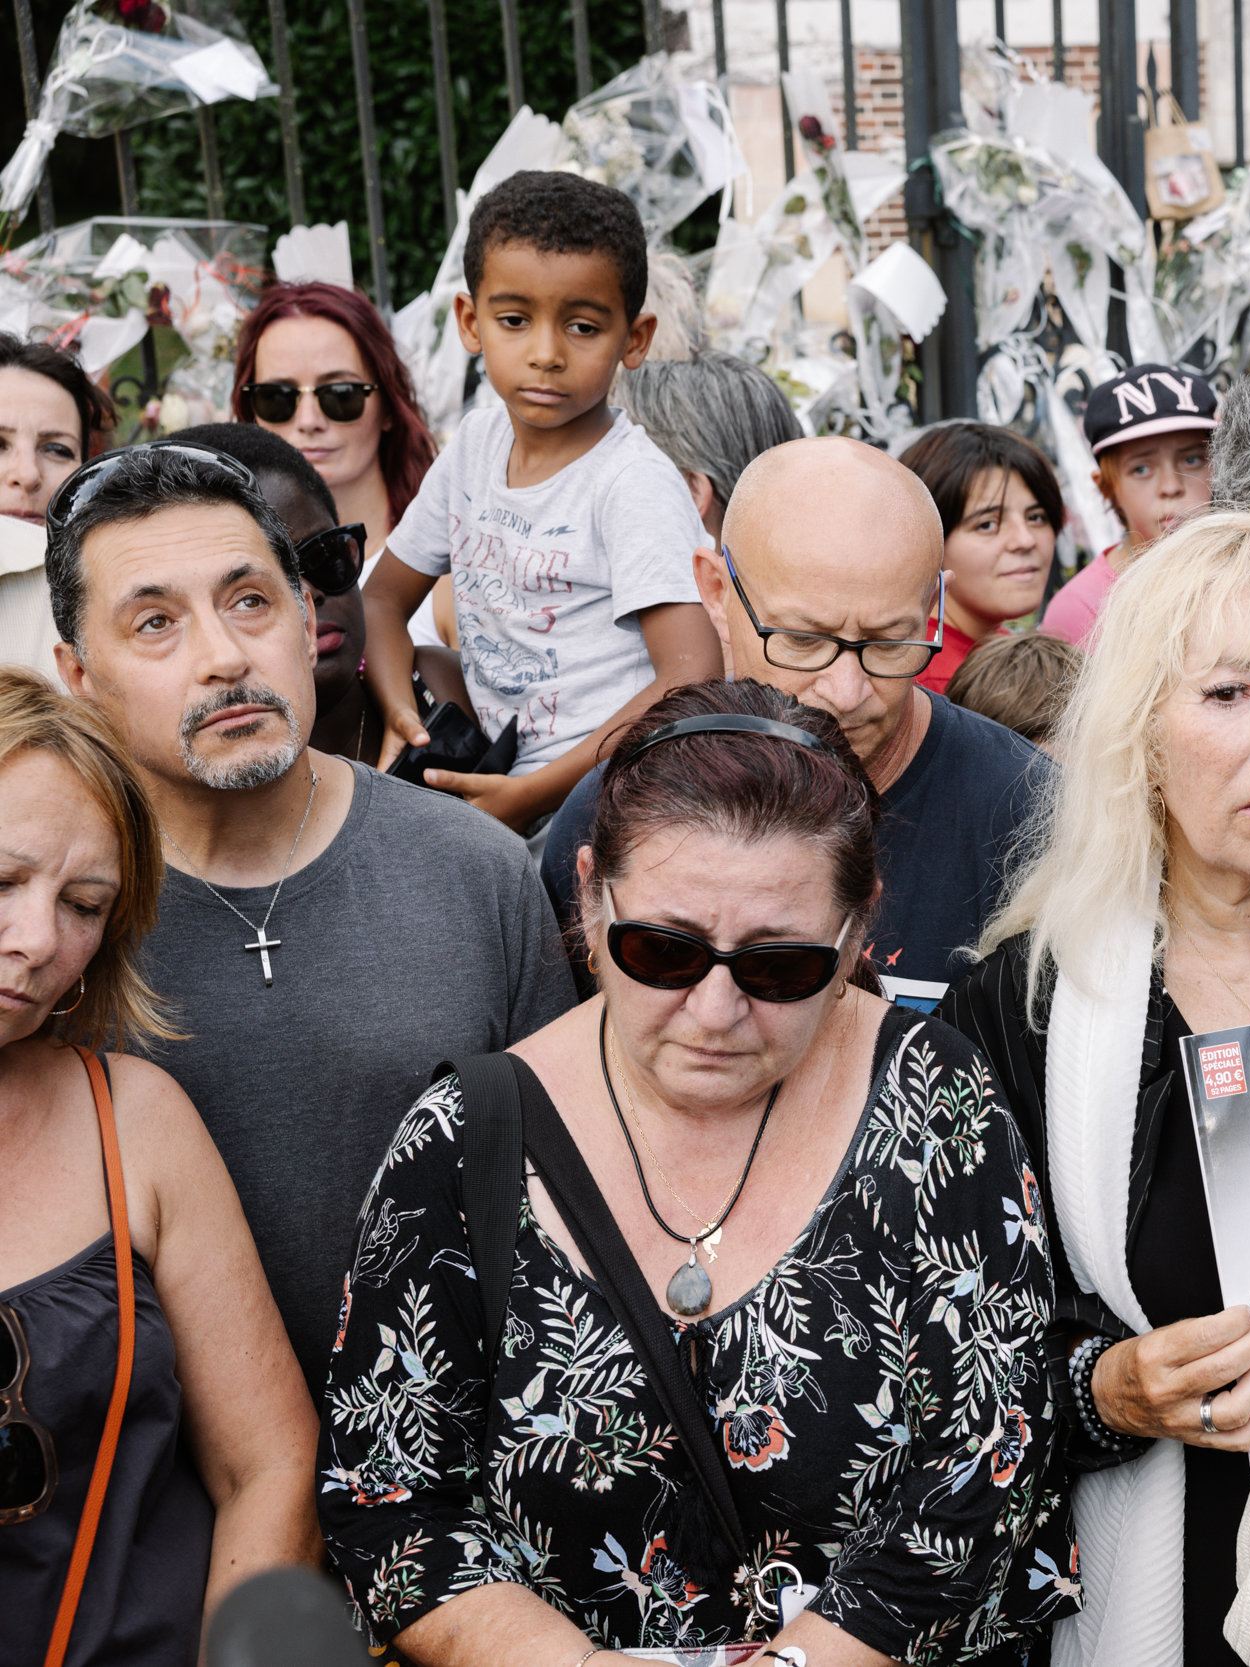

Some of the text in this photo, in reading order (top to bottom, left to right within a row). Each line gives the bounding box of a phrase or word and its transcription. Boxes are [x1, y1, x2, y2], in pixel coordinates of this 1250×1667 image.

[1112, 372, 1199, 425] NY
[1201, 1047, 1239, 1061] ÉDITION
[1203, 1058, 1241, 1071] SPÉCIALE
[1205, 1069, 1243, 1087] 4,90 €
[1220, 1084, 1242, 1093] PAGES
